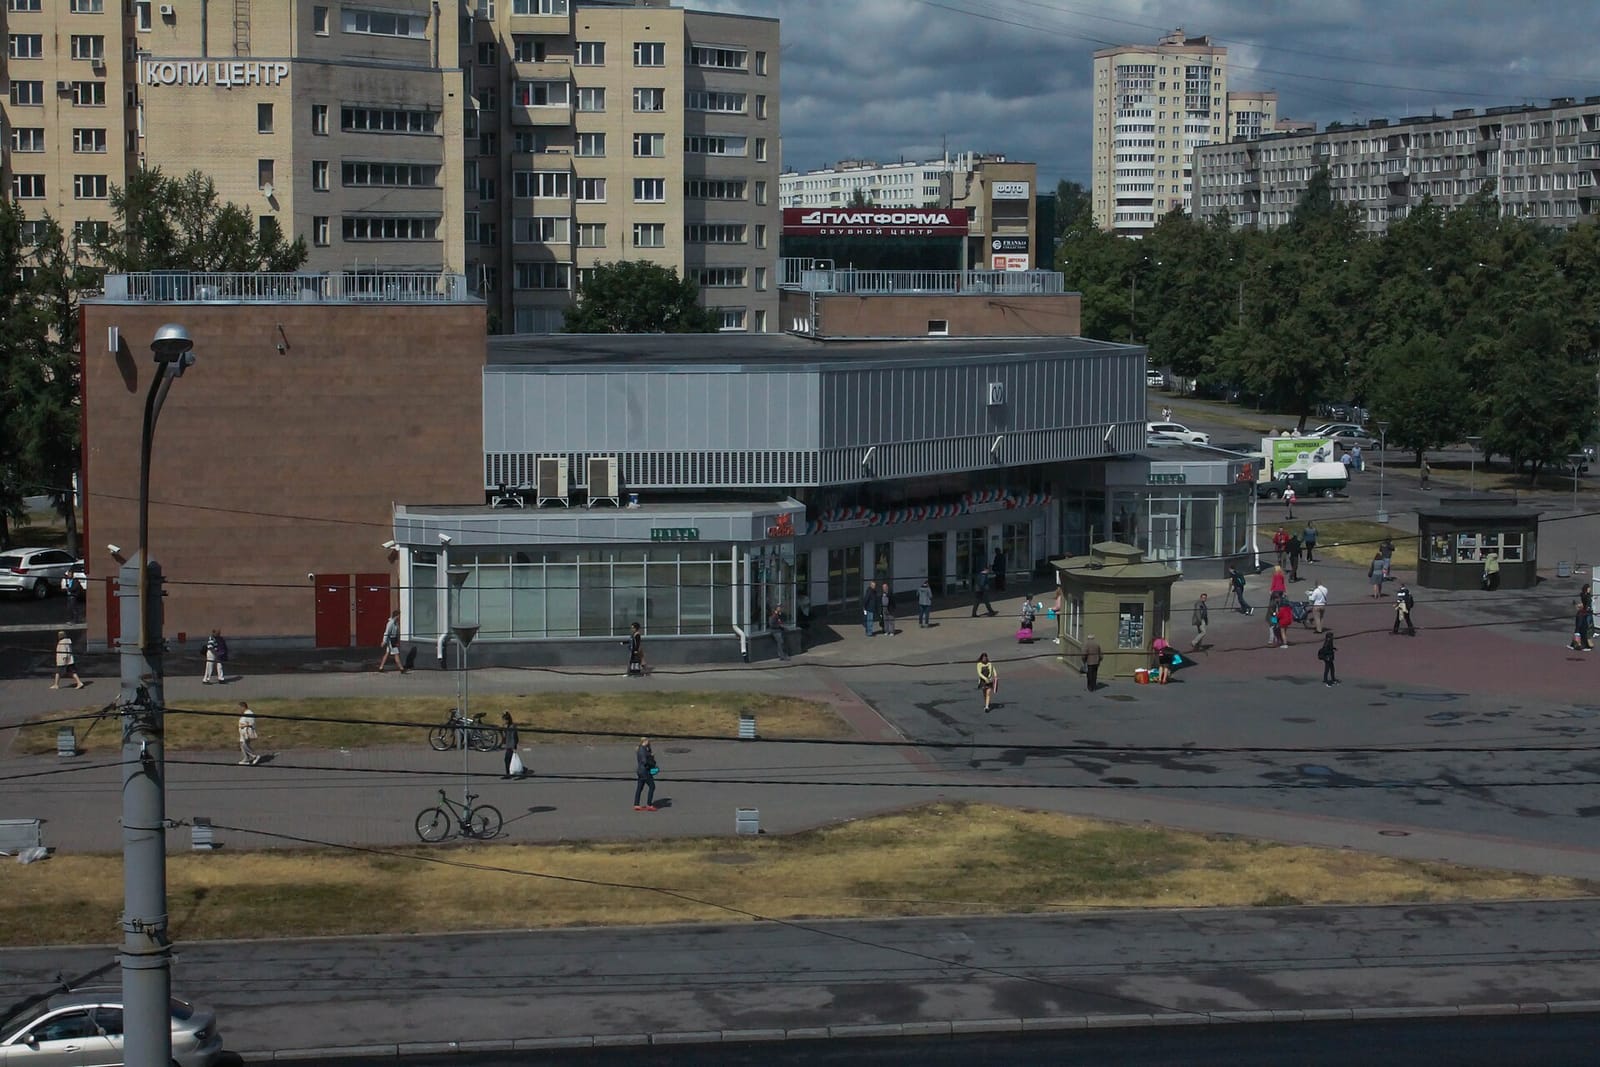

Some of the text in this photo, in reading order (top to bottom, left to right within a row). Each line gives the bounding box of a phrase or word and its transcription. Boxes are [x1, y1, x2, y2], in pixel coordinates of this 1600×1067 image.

[147, 63, 289, 88] КОПИ ЦЕНТР
[997, 184, 1023, 193] ФОТО
[822, 213, 949, 225] ПЛАТФОРМА
[820, 227, 883, 235] ОБУВНОЙ
